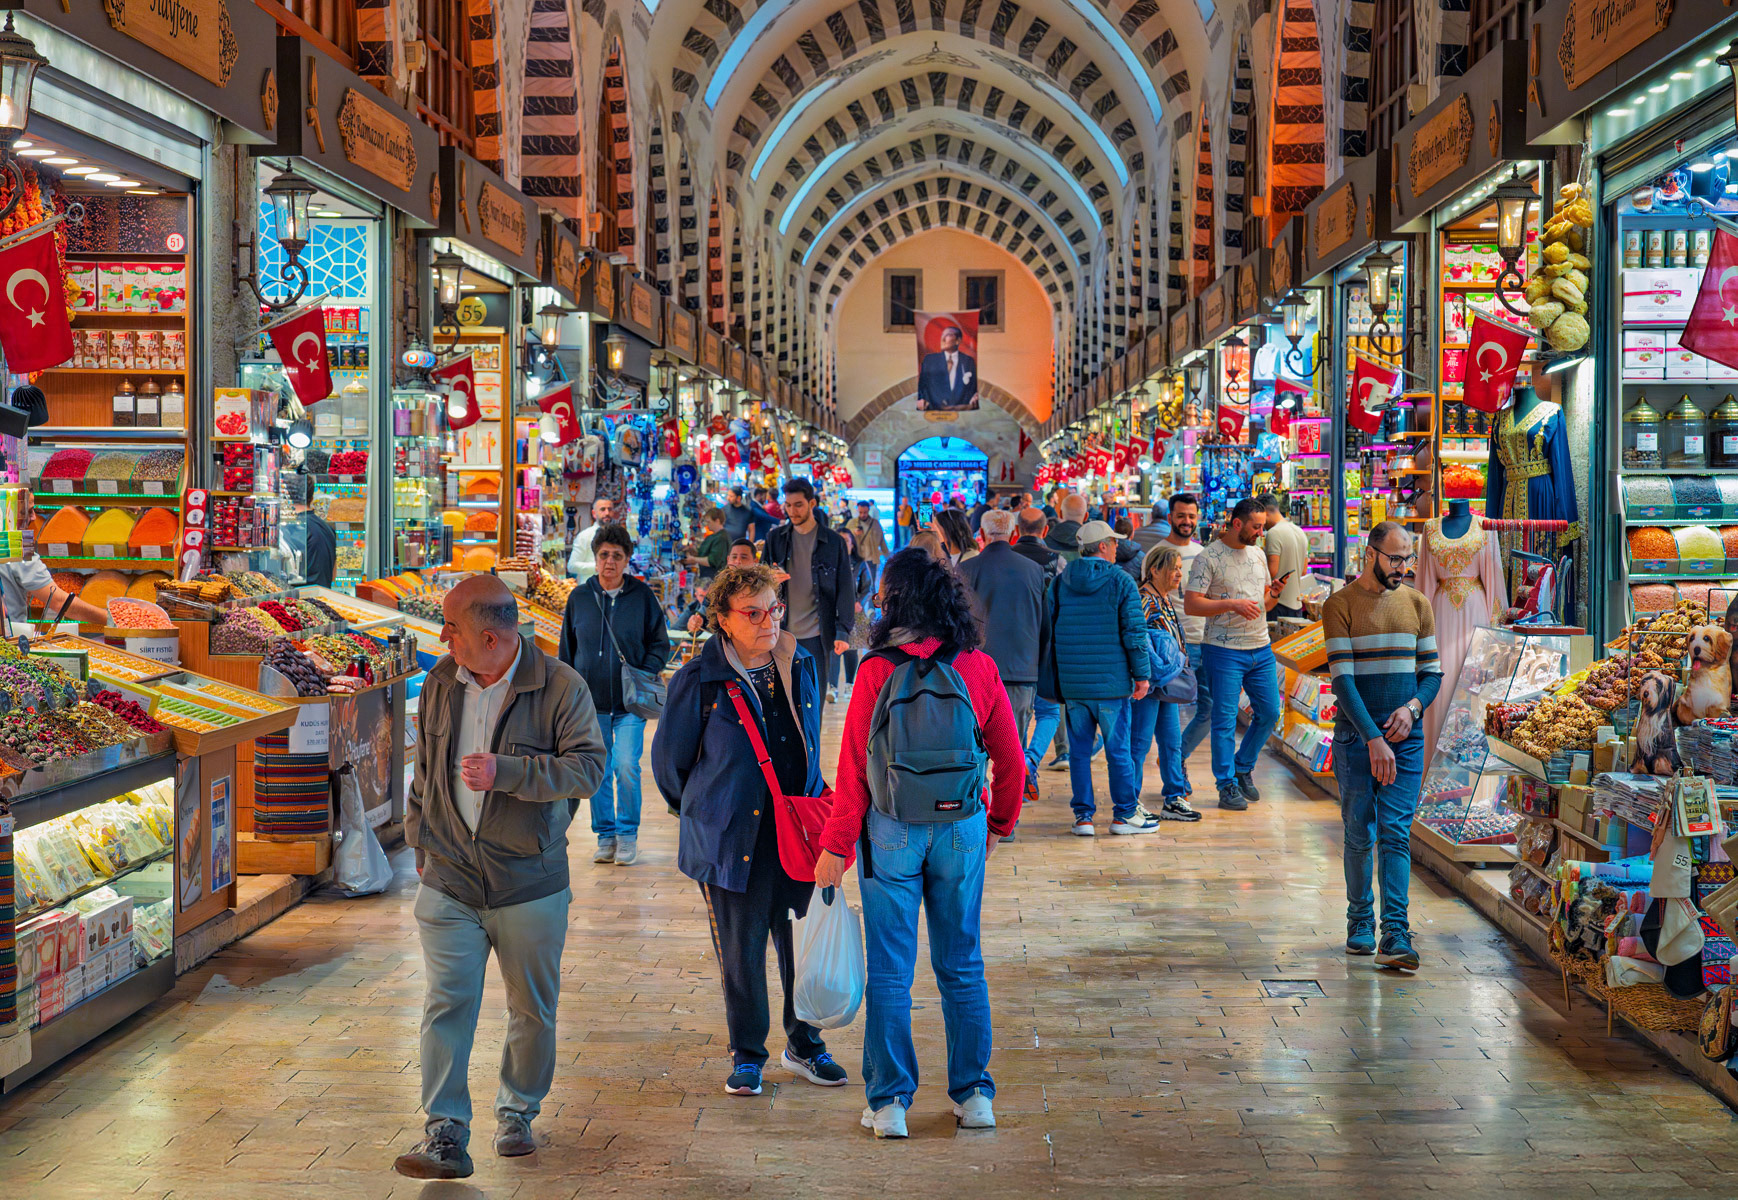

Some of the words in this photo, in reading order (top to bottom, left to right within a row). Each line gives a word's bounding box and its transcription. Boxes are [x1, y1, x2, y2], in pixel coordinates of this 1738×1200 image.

[268, 86, 276, 114] 51
[170, 233, 180, 248] 51
[462, 304, 483, 322] 55
[1674, 854, 1689, 867] 55
